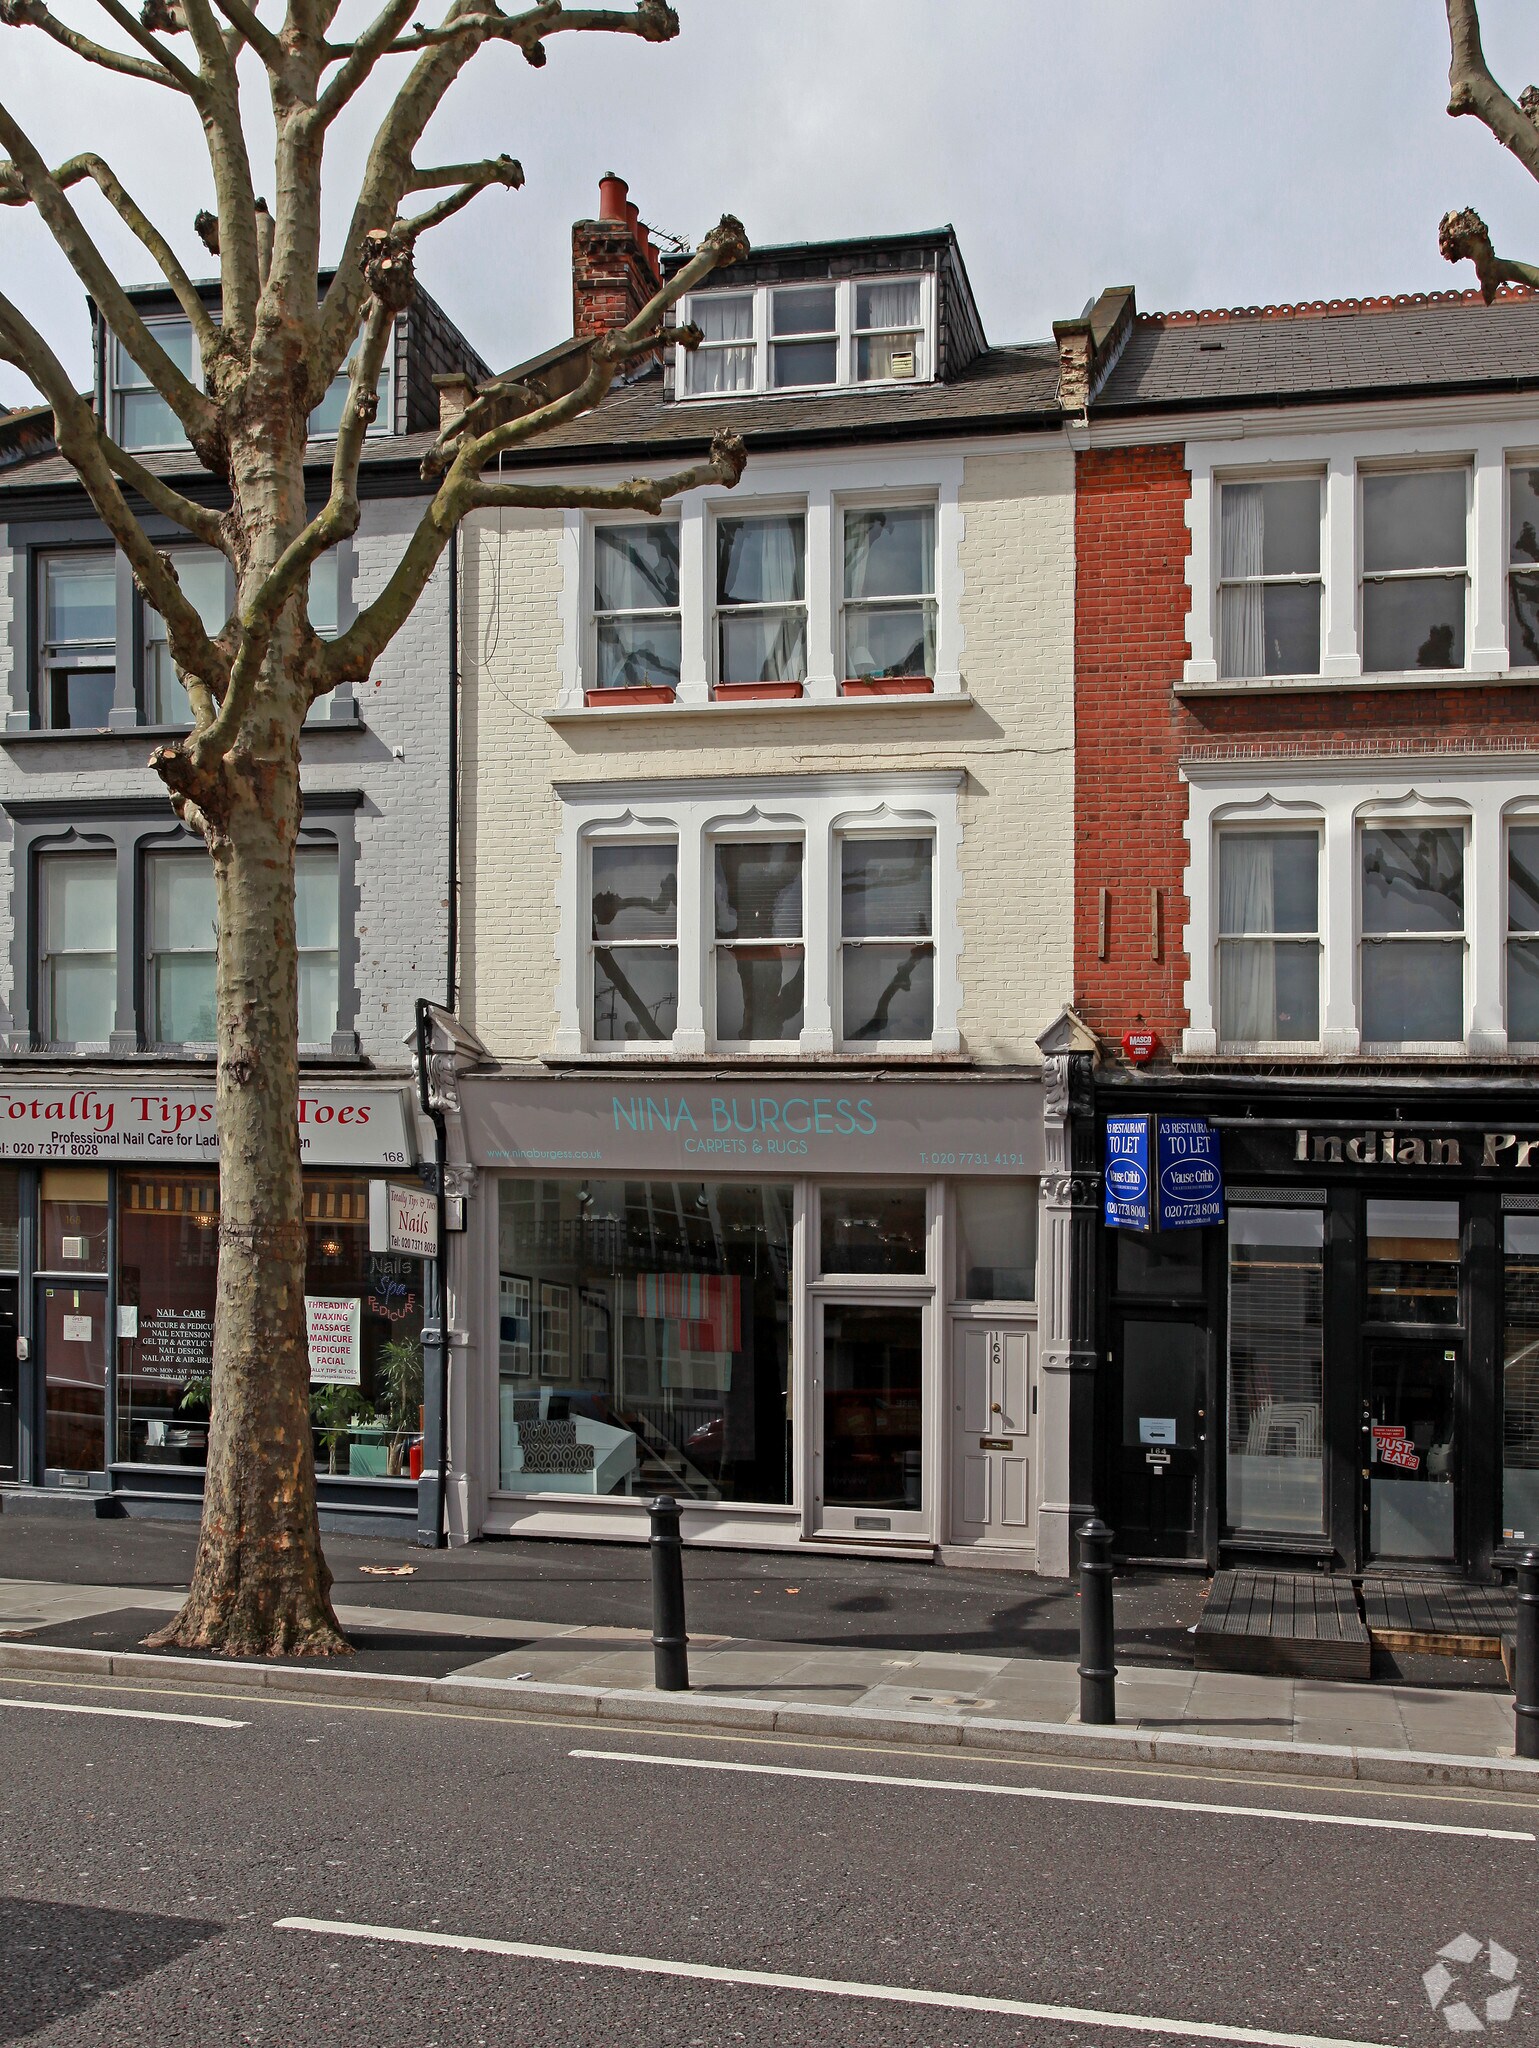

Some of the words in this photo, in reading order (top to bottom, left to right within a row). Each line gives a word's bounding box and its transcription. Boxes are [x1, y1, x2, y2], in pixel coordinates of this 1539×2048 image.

[1130, 1036, 1152, 1046] MASCO
[130, 1096, 214, 1134] Tips
[298, 1099, 372, 1125] Toes
[612, 1097, 698, 1132] NINA
[711, 1098, 877, 1135] BURGESS
[1113, 1123, 1146, 1134] RESTAURANT
[1160, 1124, 1170, 1134] A3
[51, 1131, 120, 1145] Professional
[123, 1133, 144, 1146] Nail
[148, 1133, 174, 1146] Care
[177, 1134, 192, 1147] for
[684, 1138, 747, 1154] CARPETS
[752, 1138, 763, 1154] &
[767, 1139, 808, 1155] RUGS
[1109, 1136, 1120, 1154] TO
[1122, 1136, 1140, 1154] LET
[1168, 1136, 1187, 1155] TO
[1190, 1136, 1211, 1154] LET
[13, 1142, 33, 1154] 020
[38, 1143, 66, 1155] 7371
[71, 1145, 99, 1156] 8028
[487, 1148, 602, 1161] www.ninaburgess.co.uk
[1293, 1129, 1463, 1166] Indian
[383, 1152, 405, 1163] 168
[920, 1152, 929, 1164] T:
[931, 1152, 955, 1164] 020
[959, 1153, 989, 1165] 7731
[994, 1153, 1024, 1165] 4191
[1110, 1170, 1125, 1183] Vause
[1124, 1170, 1141, 1184] Cribb
[1170, 1172, 1195, 1184] Vause
[1195, 1169, 1215, 1183] Cribb
[391, 1190, 408, 1209] Totally
[408, 1194, 419, 1211] Tips
[426, 1198, 437, 1210] Toes
[1106, 1201, 1118, 1214] 020
[1118, 1203, 1131, 1216] 7731
[1130, 1204, 1146, 1218] 8001
[1164, 1206, 1183, 1218] 020
[1183, 1204, 1201, 1217] 7731
[1201, 1202, 1220, 1215] 8001
[398, 1209, 429, 1235] Nails
[391, 1234, 400, 1248] Tel:
[401, 1236, 411, 1249] 020
[411, 1238, 423, 1251] 7371
[424, 1240, 437, 1254] 8028
[370, 1257, 412, 1274] Nails
[375, 1276, 408, 1305] Spa
[308, 1300, 355, 1310] THREADING
[367, 1293, 416, 1321] PEDICURE
[156, 1308, 178, 1318] NAIL
[182, 1310, 206, 1319] CARE
[313, 1312, 348, 1322] WAXING
[140, 1321, 179, 1329] MANICURE
[187, 1323, 215, 1331] PEDICU
[311, 1323, 351, 1333] MASSAGE
[170, 1331, 211, 1339] EXTENSION
[309, 1334, 353, 1344] MANICURE
[311, 1345, 351, 1355] PEDICURE
[993, 1331, 1001, 1364] 166
[316, 1356, 346, 1366] FACIAL
[159, 1367, 174, 1375] MON
[1150, 1447, 1167, 1455] 164
[1378, 1437, 1412, 1453] JUST
[1383, 1449, 1409, 1465] EAT
